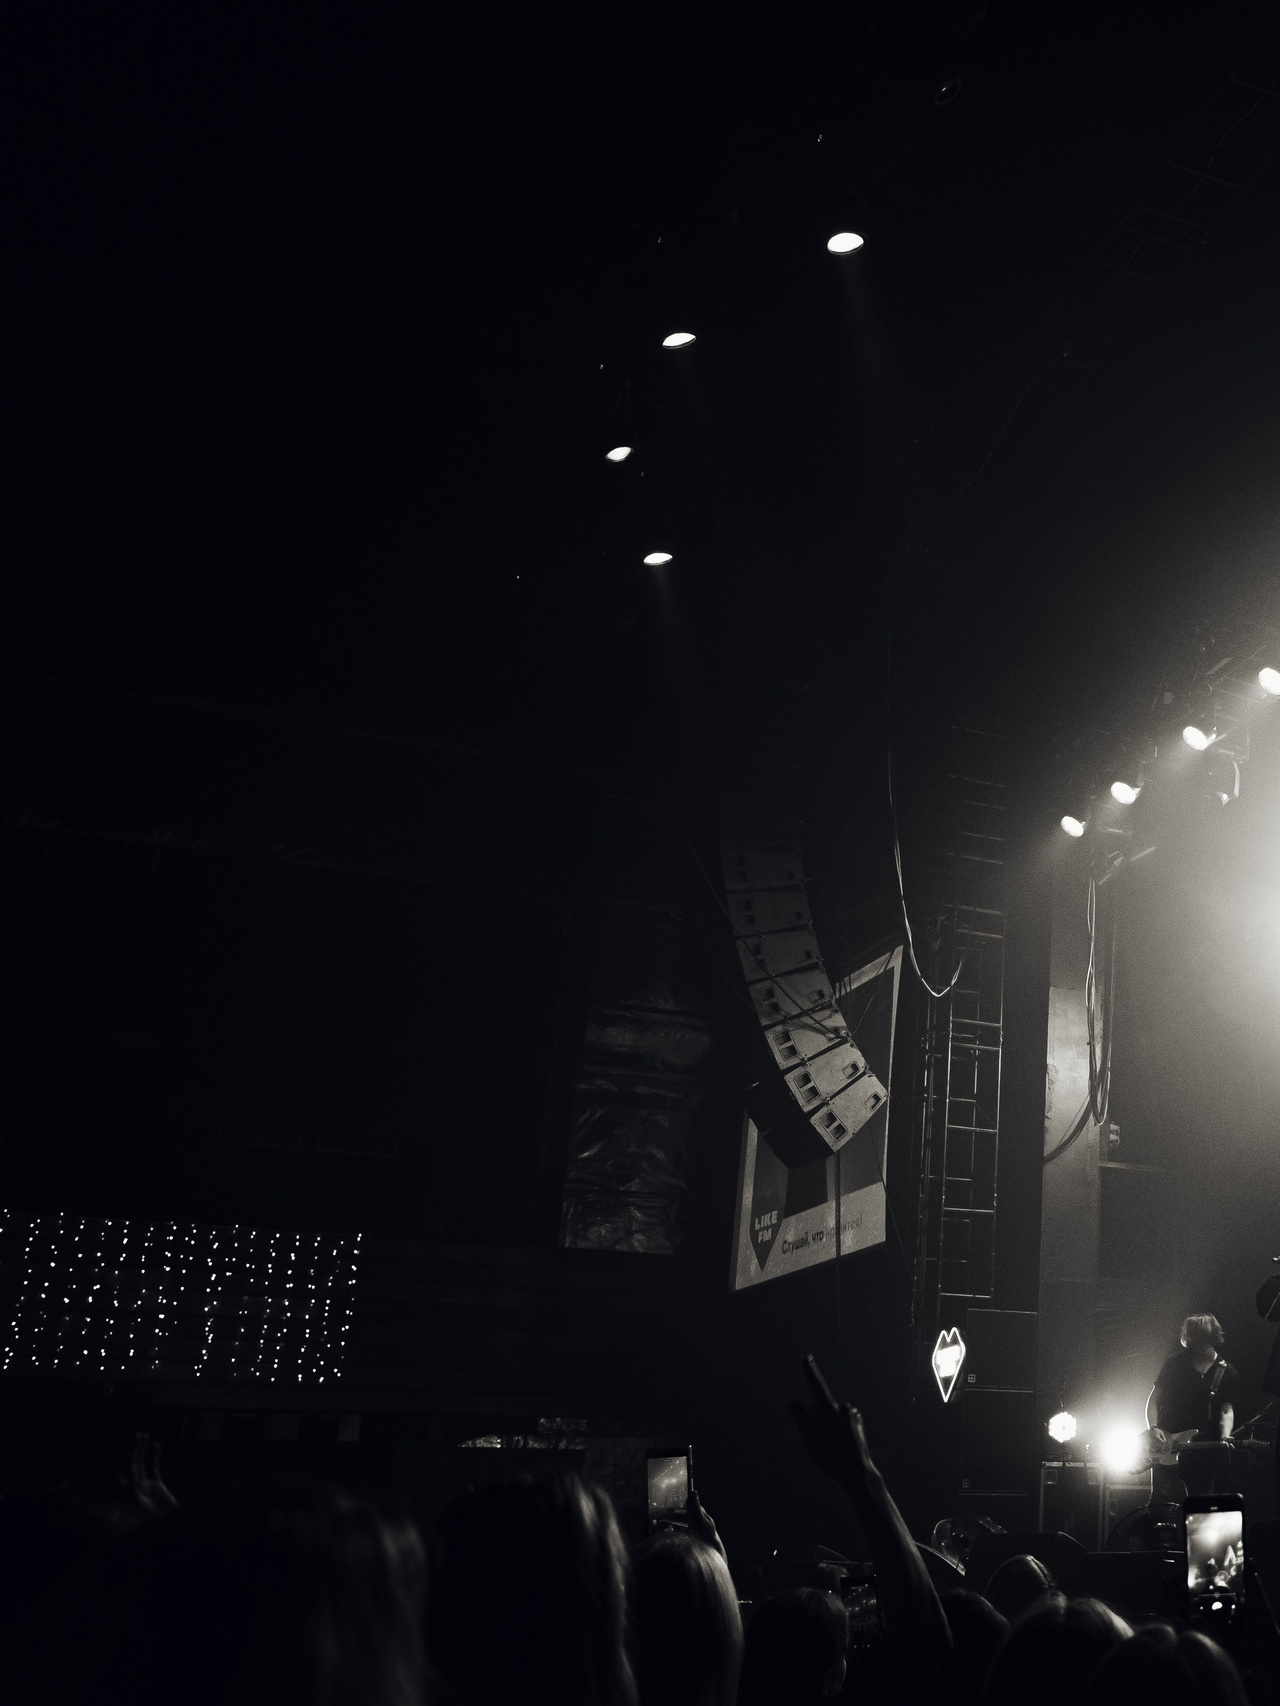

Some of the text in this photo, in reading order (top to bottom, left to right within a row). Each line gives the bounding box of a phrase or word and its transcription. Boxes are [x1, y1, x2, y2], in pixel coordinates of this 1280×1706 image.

[755, 1210, 778, 1230] LIKE
[758, 1228, 772, 1243] FM
[812, 1230, 824, 1243] что
